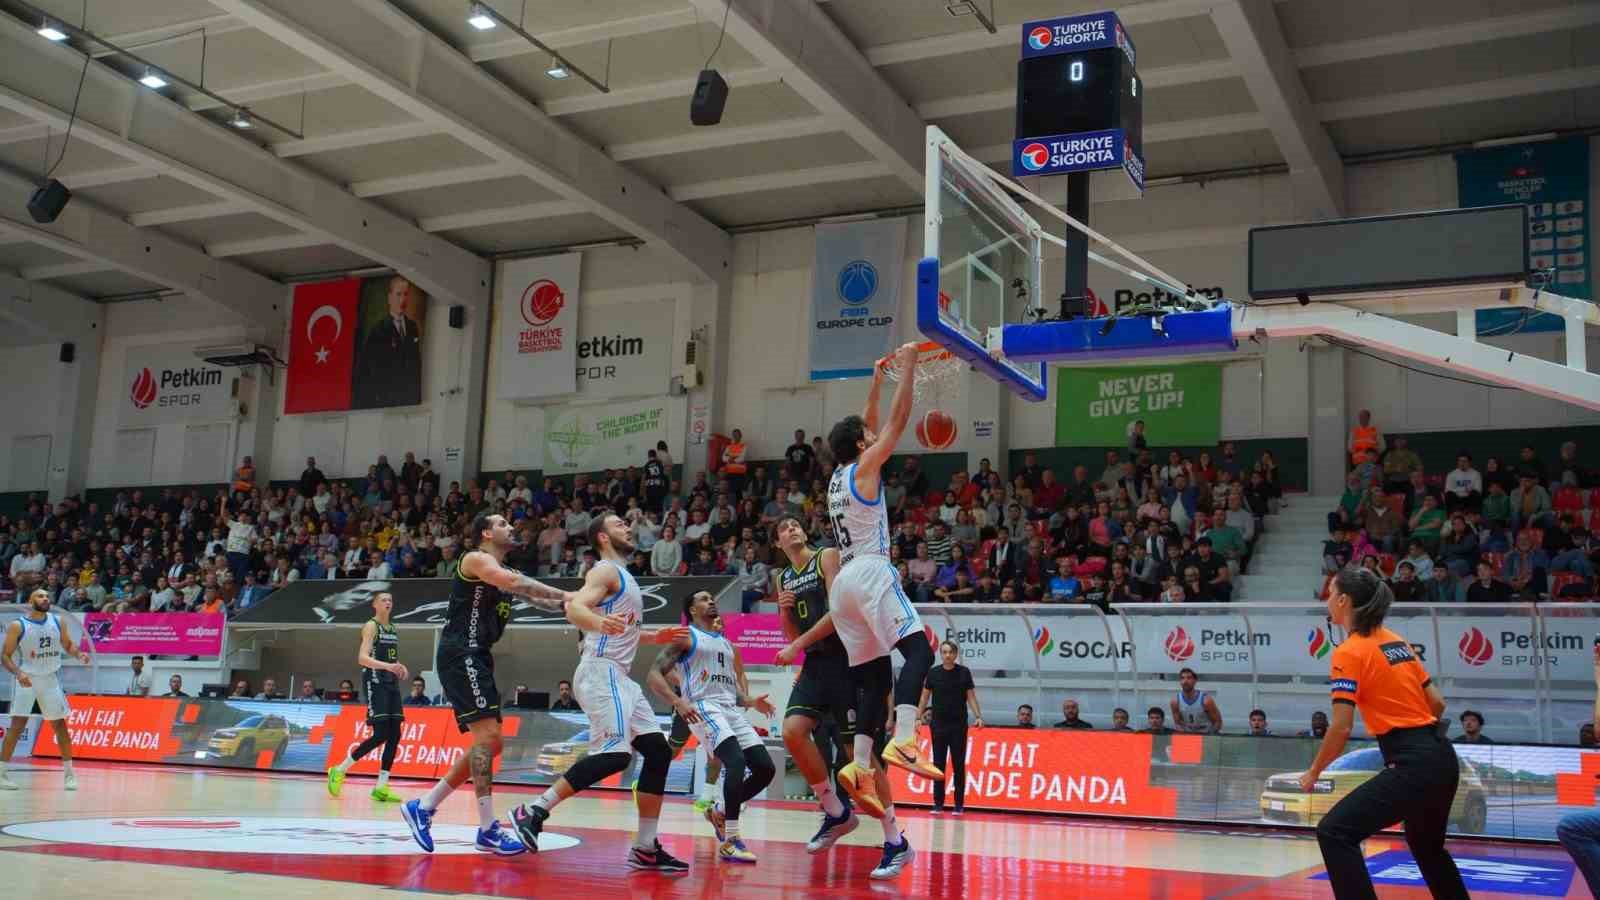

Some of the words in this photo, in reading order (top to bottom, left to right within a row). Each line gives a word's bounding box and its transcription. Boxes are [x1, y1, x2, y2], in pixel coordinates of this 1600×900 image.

[1070, 61, 1084, 82] 0
[817, 318, 865, 329] EUROPE
[868, 316, 894, 327] CUP
[576, 334, 643, 358] etkim
[160, 367, 222, 388] Petkim
[1099, 372, 1174, 397] NEVER
[159, 393, 202, 407] SPOR
[1089, 397, 1140, 418] GIVE
[1147, 390, 1184, 412] UP!
[798, 600, 808, 618] 0
[39, 637, 51, 648] 23
[1201, 629, 1271, 646] Petkim
[1501, 632, 1584, 649] Petkim
[1059, 641, 1136, 659] SOCAR
[1200, 651, 1249, 662] SPOR
[718, 651, 725, 668] 4
[1501, 655, 1559, 666] SPOR
[95, 710, 125, 727] FIAT
[113, 731, 161, 749] PANDA
[984, 741, 1040, 768] FIAT
[1029, 773, 1128, 804] PANDA
